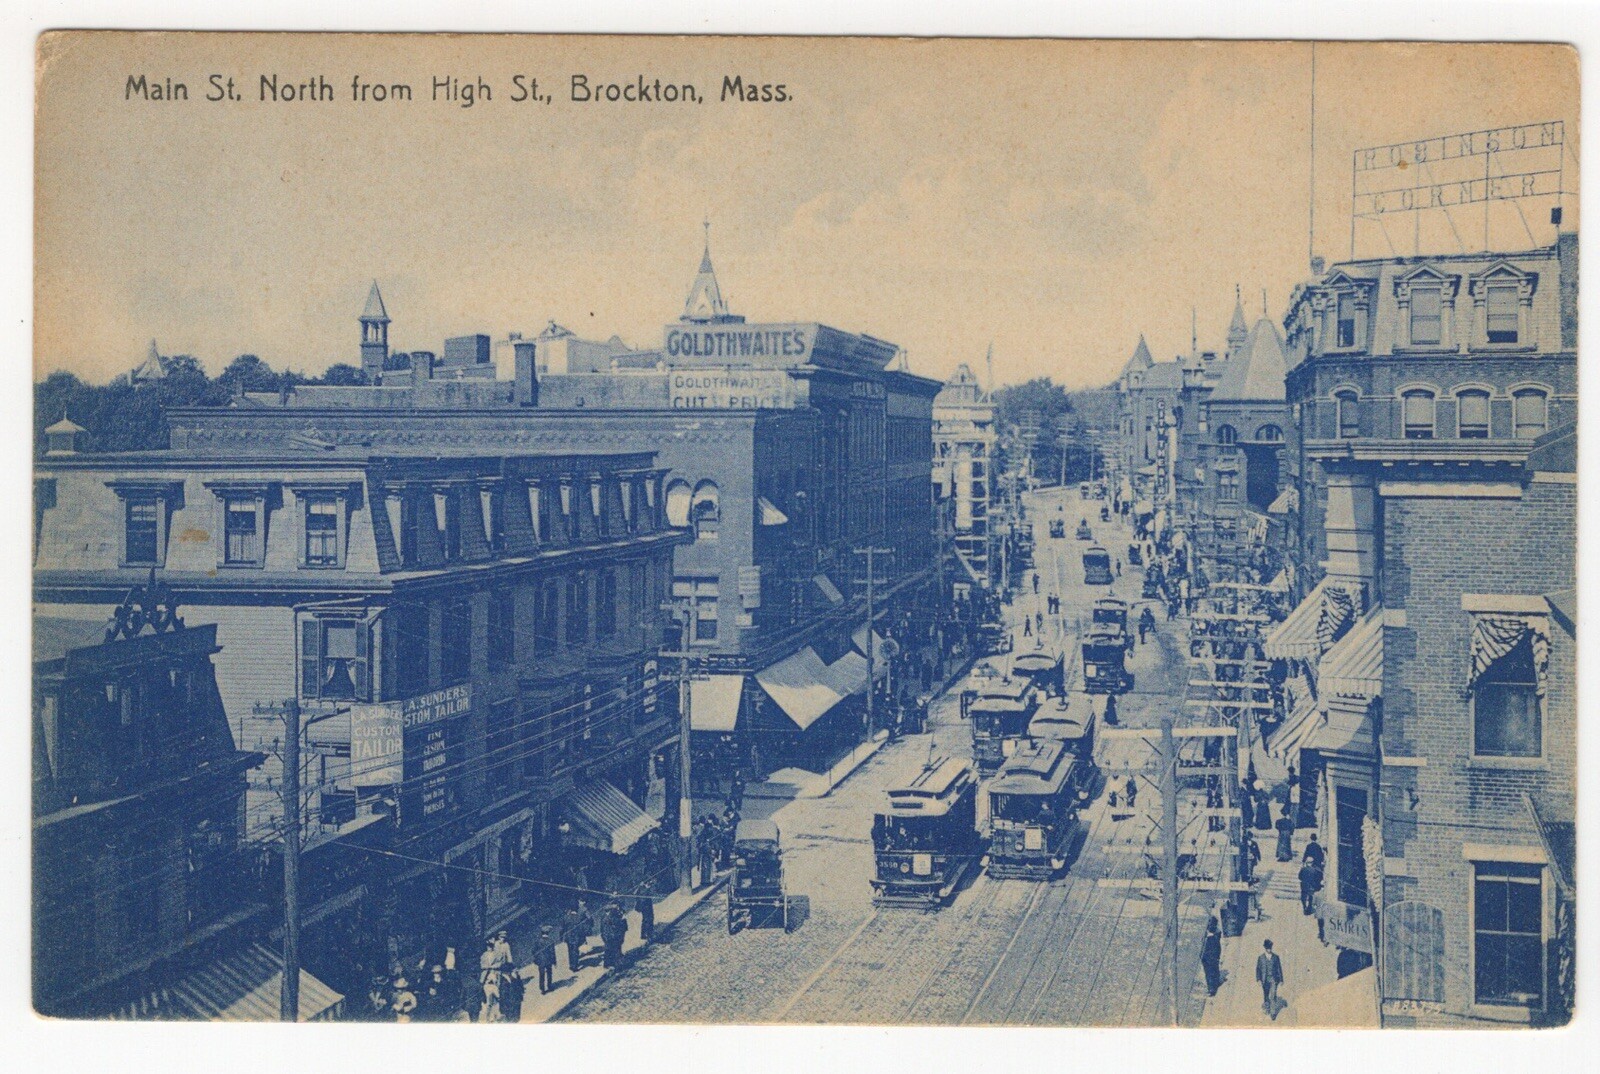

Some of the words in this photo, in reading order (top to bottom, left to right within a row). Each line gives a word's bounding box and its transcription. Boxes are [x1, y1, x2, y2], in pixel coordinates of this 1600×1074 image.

[1363, 122, 1562, 170] ROBINSON
[1373, 174, 1535, 214] CORNER
[667, 327, 805, 357] GOLDTHWAITE'S
[404, 707, 431, 728] STOM
[434, 697, 470, 719] TAILOR
[354, 738, 402, 759] TAILOR
[1329, 918, 1369, 937] SKIRTS
